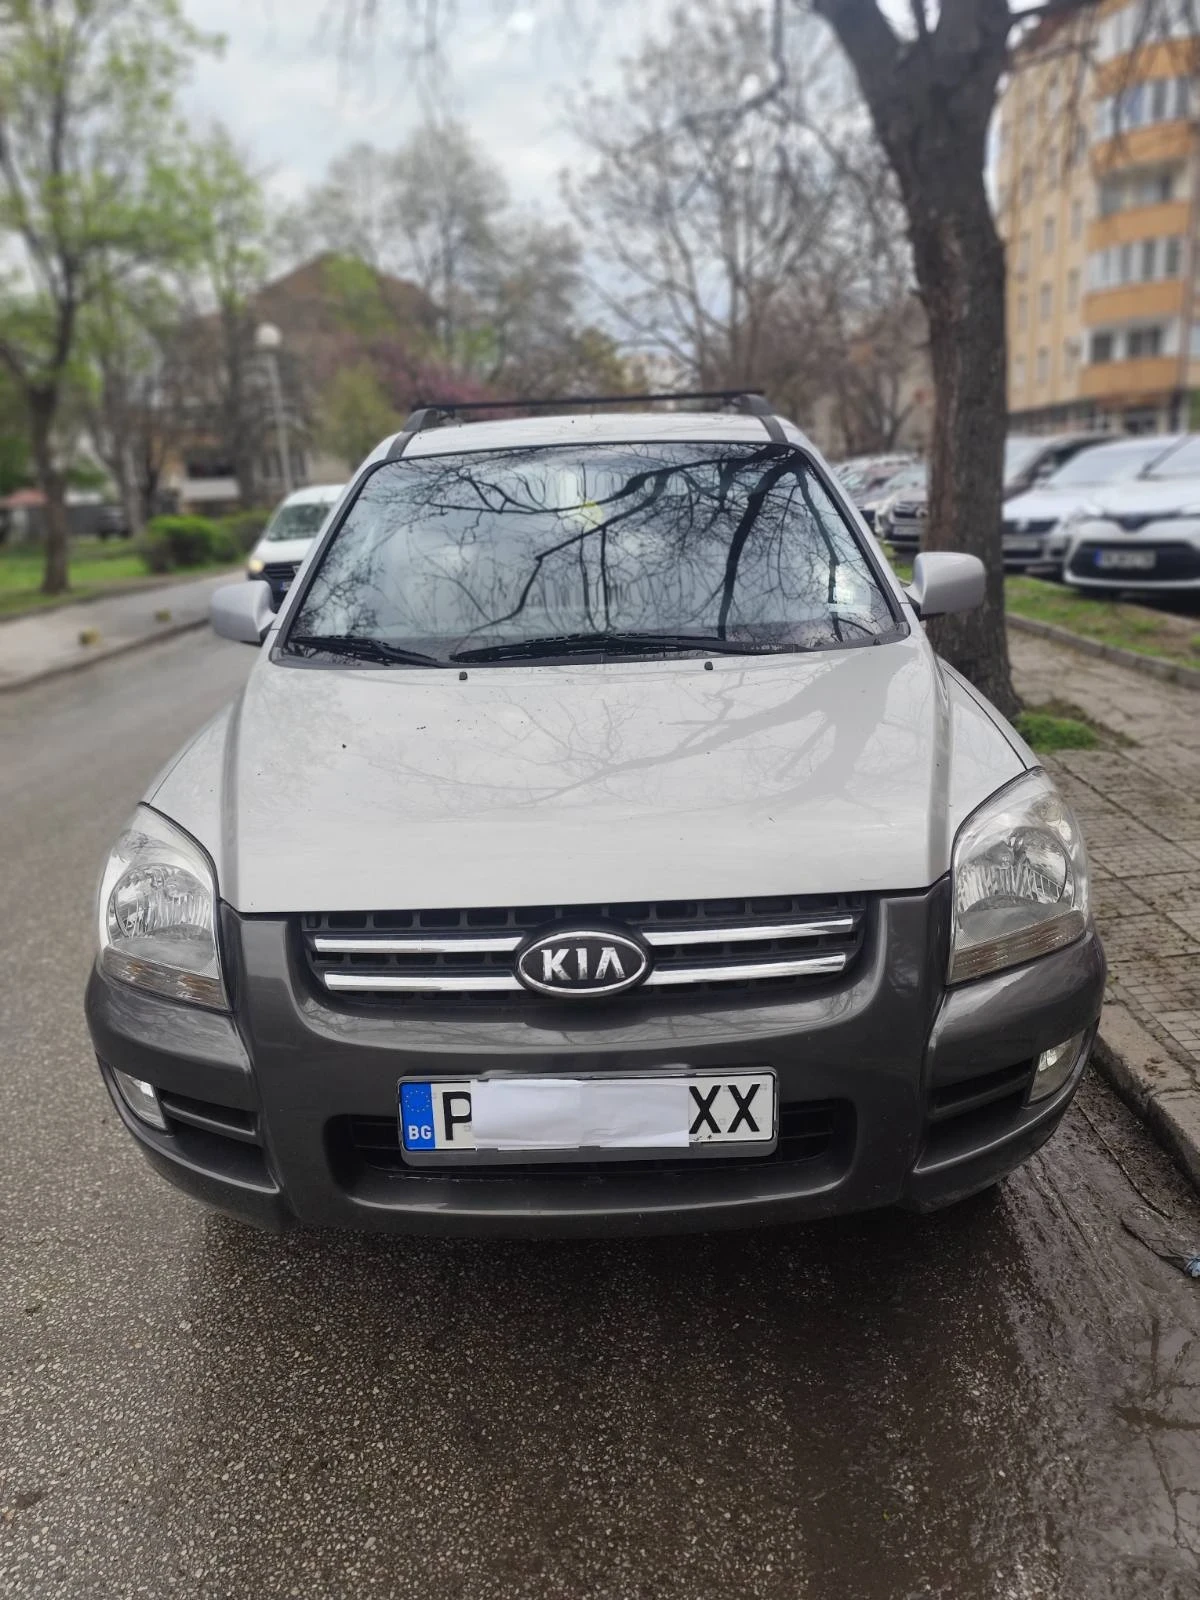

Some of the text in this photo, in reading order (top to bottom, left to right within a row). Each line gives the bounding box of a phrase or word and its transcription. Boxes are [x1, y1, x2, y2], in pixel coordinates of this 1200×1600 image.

[540, 947, 626, 981] KIA
[442, 1083, 761, 1141] P XX
[408, 1125, 432, 1140] BG
